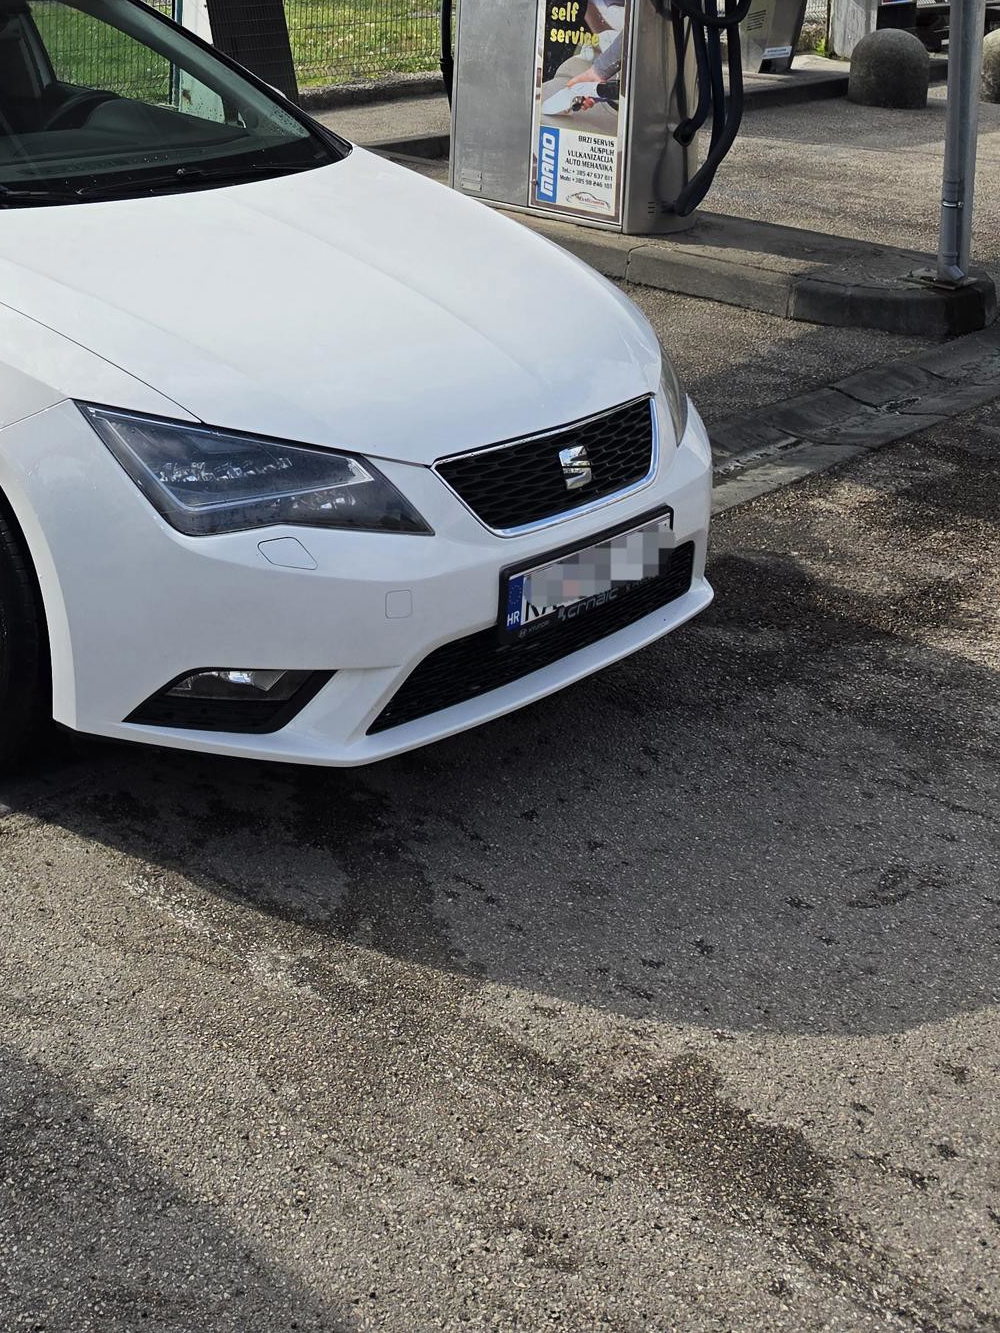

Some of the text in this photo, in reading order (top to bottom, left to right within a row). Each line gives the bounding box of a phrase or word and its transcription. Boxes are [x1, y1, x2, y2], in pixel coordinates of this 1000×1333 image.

[551, 1, 580, 22] self
[578, 135, 615, 147] BRZI SERVIS
[567, 149, 614, 164] VULKANIZACIJA
[590, 146, 615, 156] AUSPUH
[566, 157, 613, 172] AUTO MEHANIKA
[507, 611, 520, 627] HR
